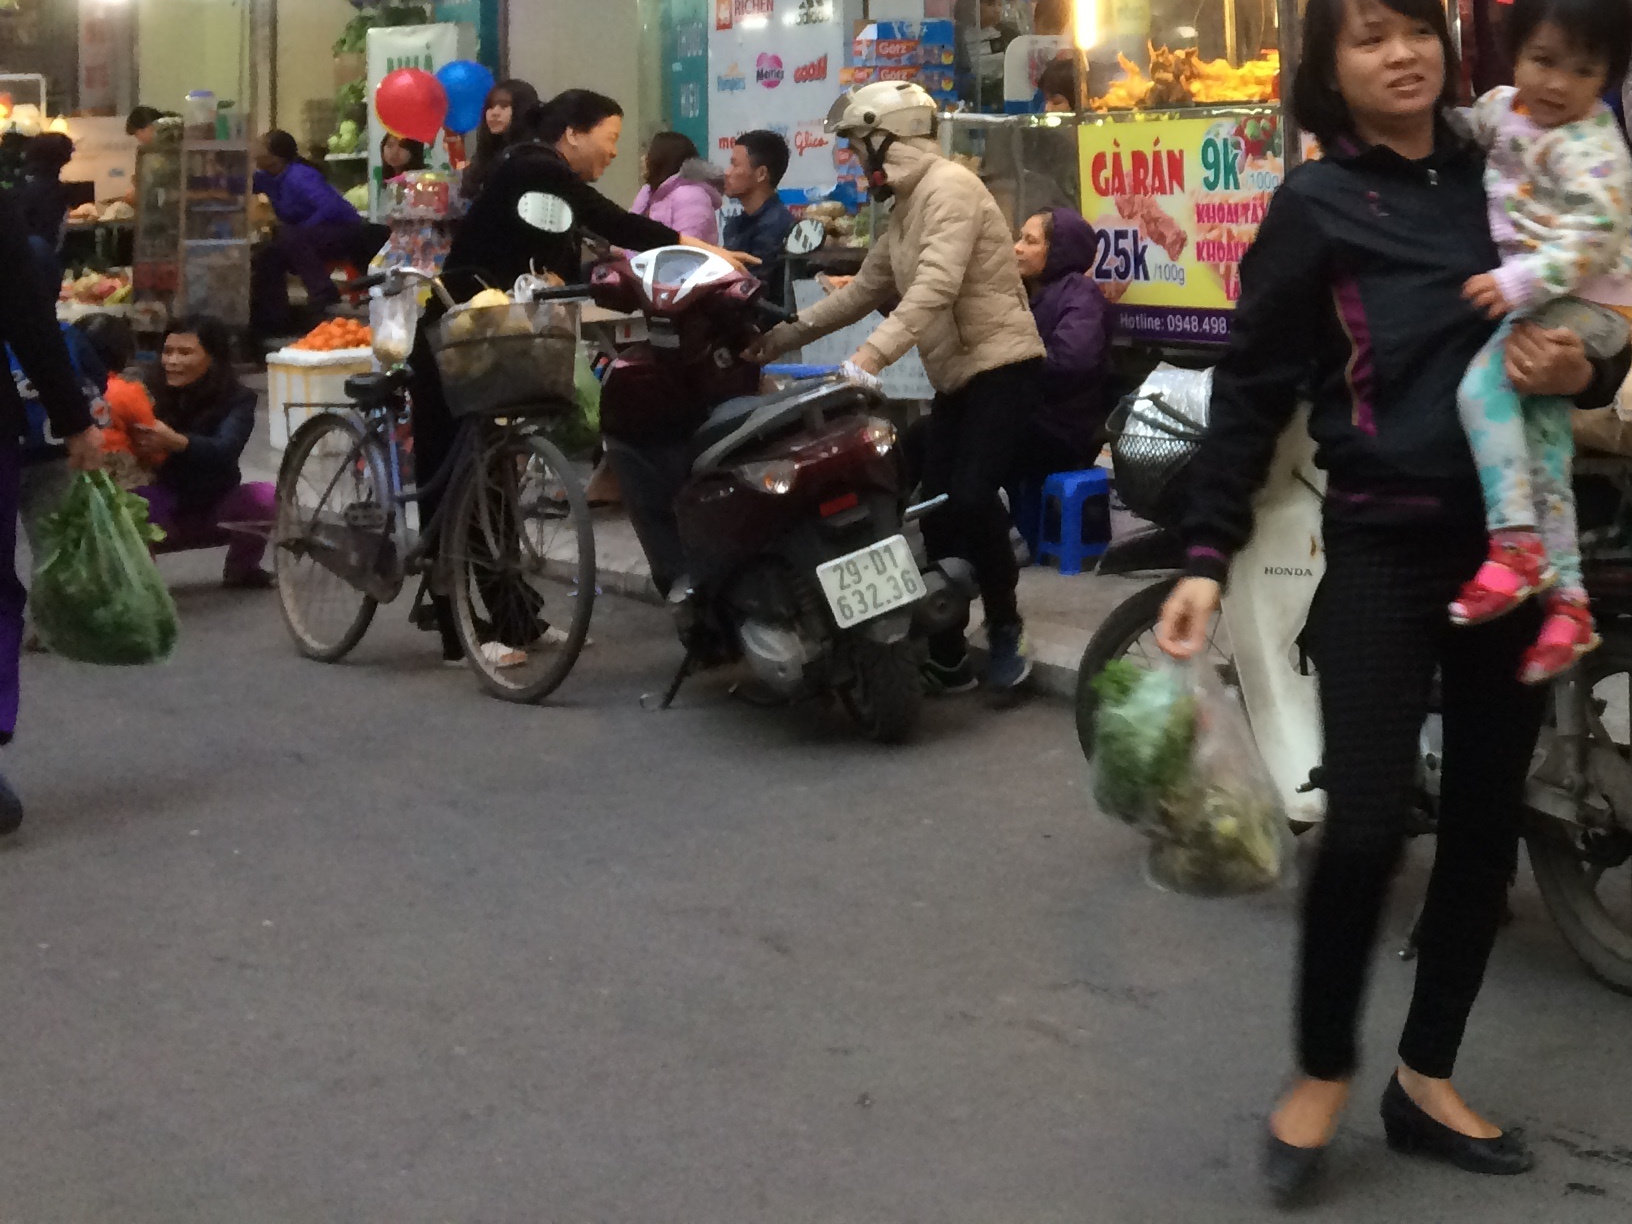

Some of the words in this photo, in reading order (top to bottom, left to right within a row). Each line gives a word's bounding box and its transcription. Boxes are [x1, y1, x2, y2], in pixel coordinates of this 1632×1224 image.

[1091, 138, 1127, 197] GÀ
[1131, 137, 1185, 196] RÁN
[1201, 137, 1240, 192] 9k
[1094, 229, 1150, 281] 25k
[1166, 314, 1231, 336] 0948.498.
[836, 569, 918, 621] 632.36
[1264, 566, 1313, 577] HONDA
